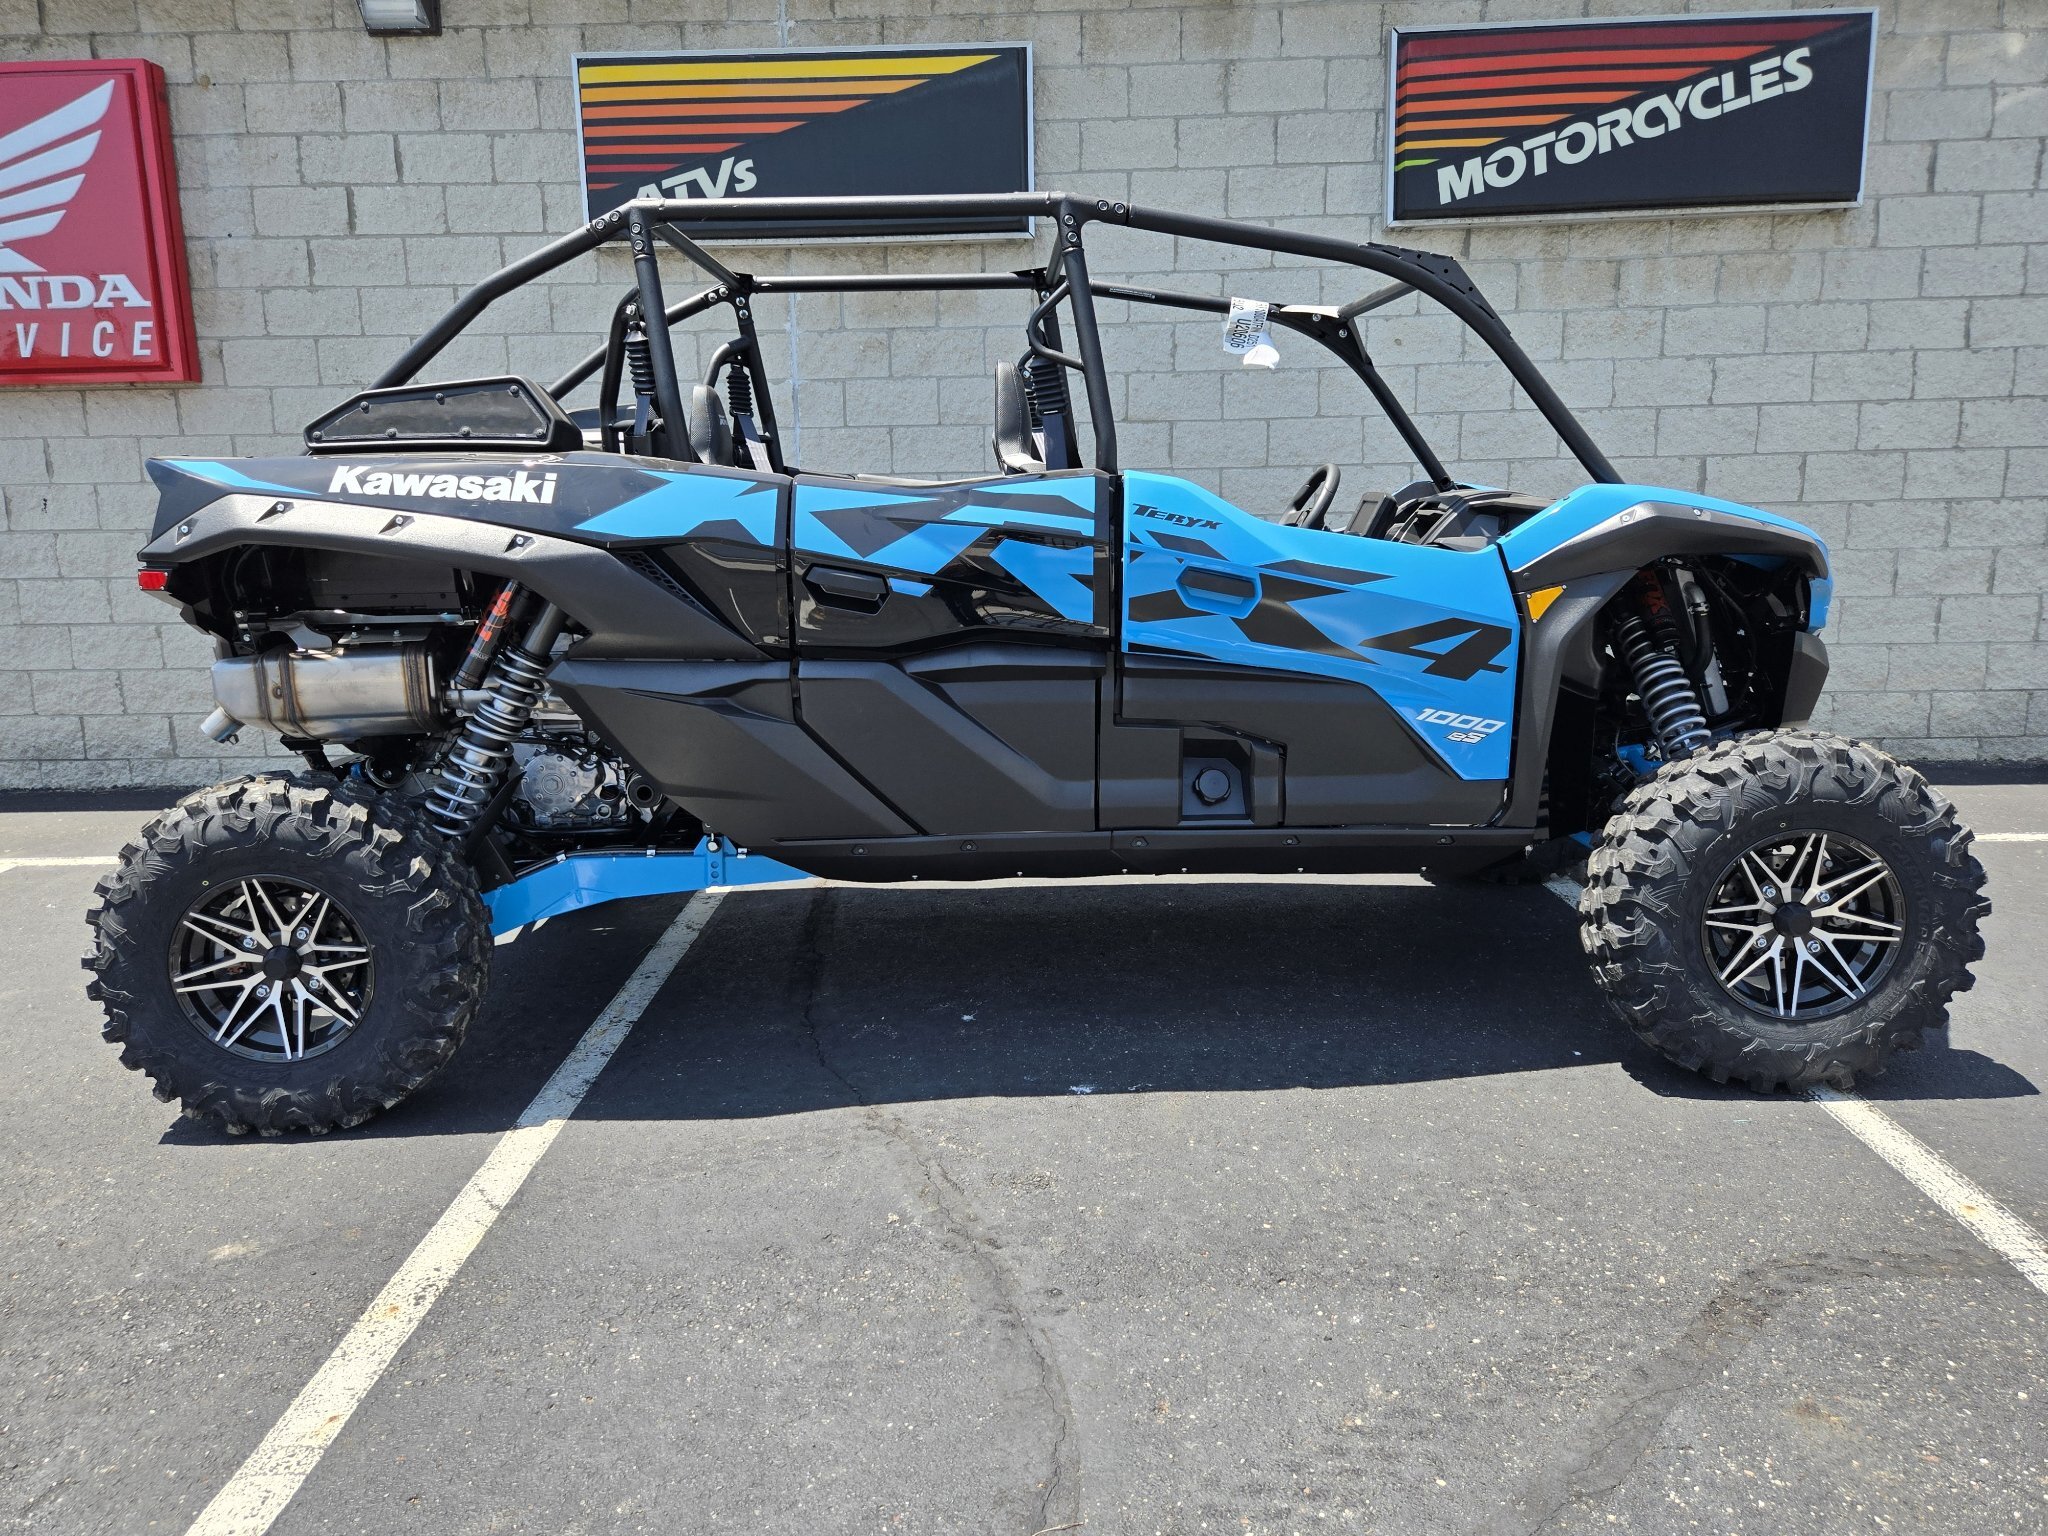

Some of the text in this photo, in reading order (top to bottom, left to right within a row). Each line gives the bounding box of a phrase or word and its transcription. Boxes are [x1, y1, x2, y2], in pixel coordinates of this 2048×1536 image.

[1437, 47, 1814, 205] MOTORCYCLES
[15, 321, 154, 358] VICE
[328, 465, 557, 504] Kawasaki
[1359, 617, 1512, 681] 4
[1415, 708, 1507, 734] 1000
